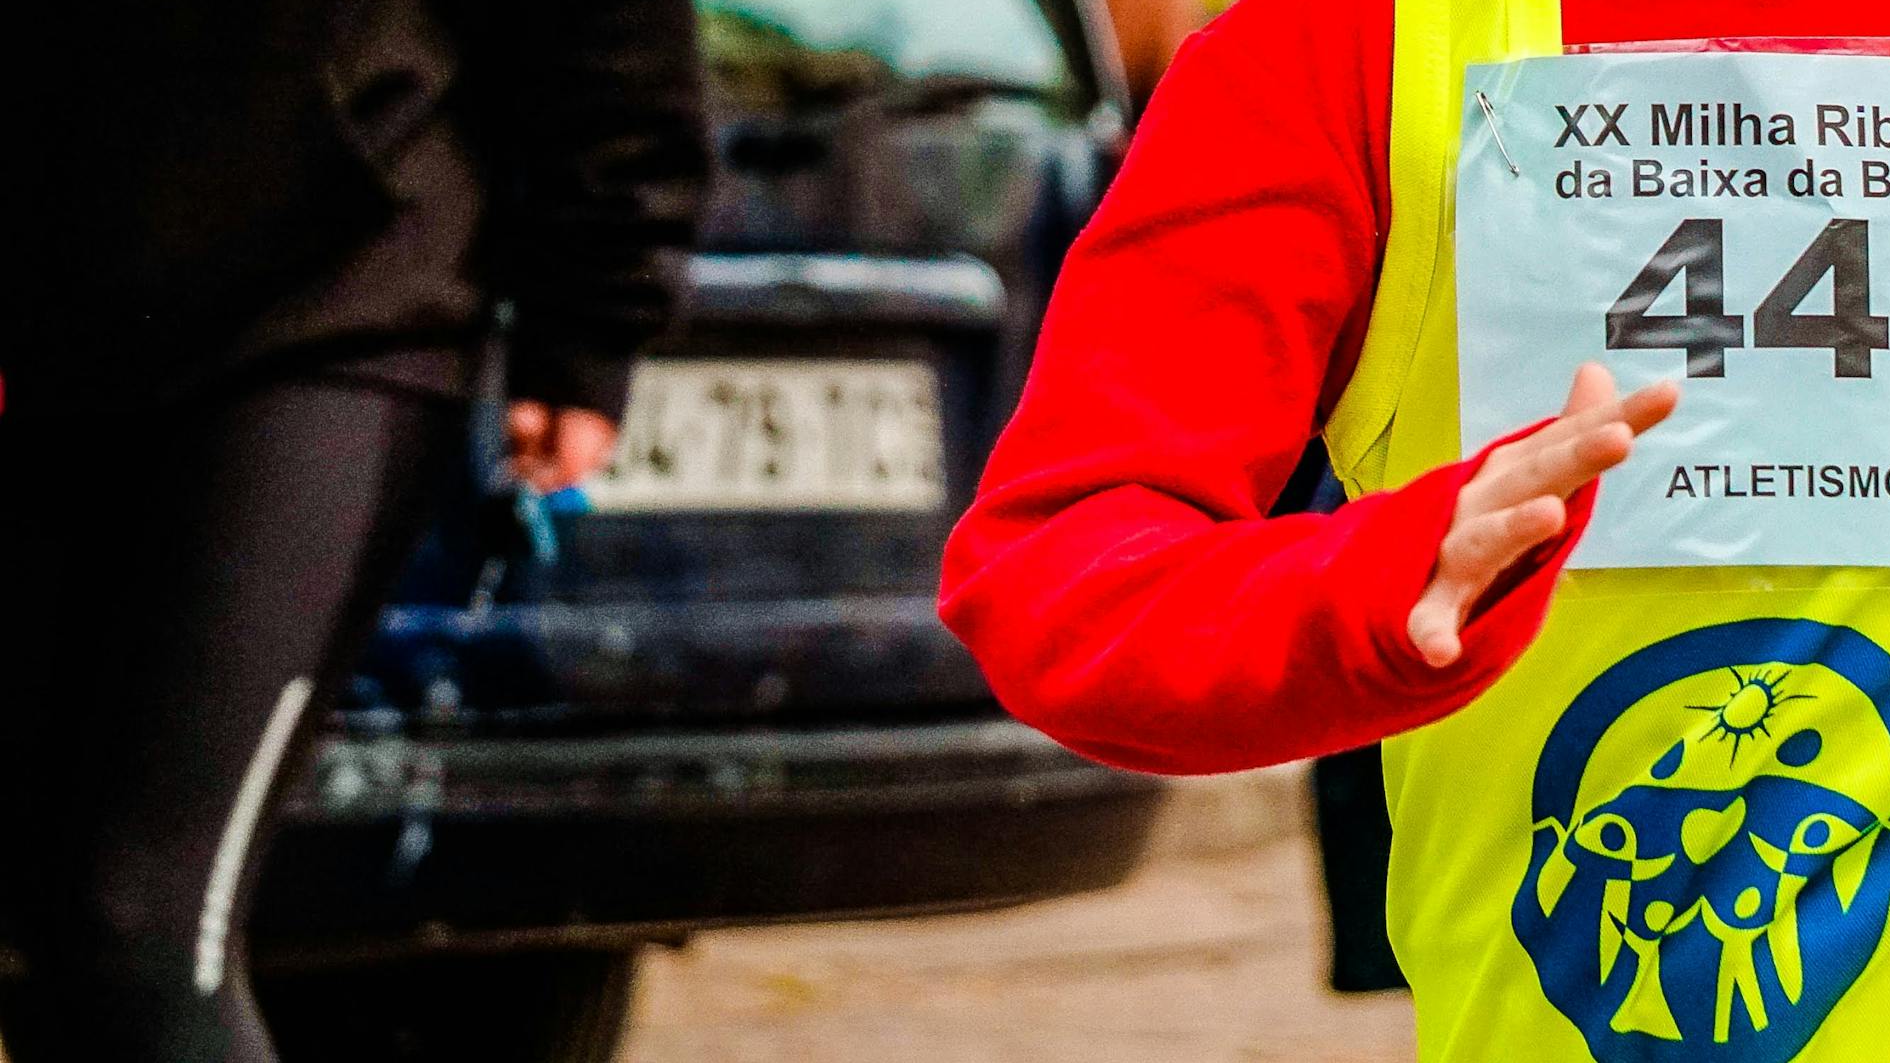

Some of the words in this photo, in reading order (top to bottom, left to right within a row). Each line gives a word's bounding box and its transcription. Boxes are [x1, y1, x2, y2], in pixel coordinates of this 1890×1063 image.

[1553, 103, 1631, 148] XX
[1651, 102, 1797, 146] Milha
[1555, 160, 1613, 200] da
[1632, 159, 1769, 198] Baixa
[1787, 158, 1844, 198] da
